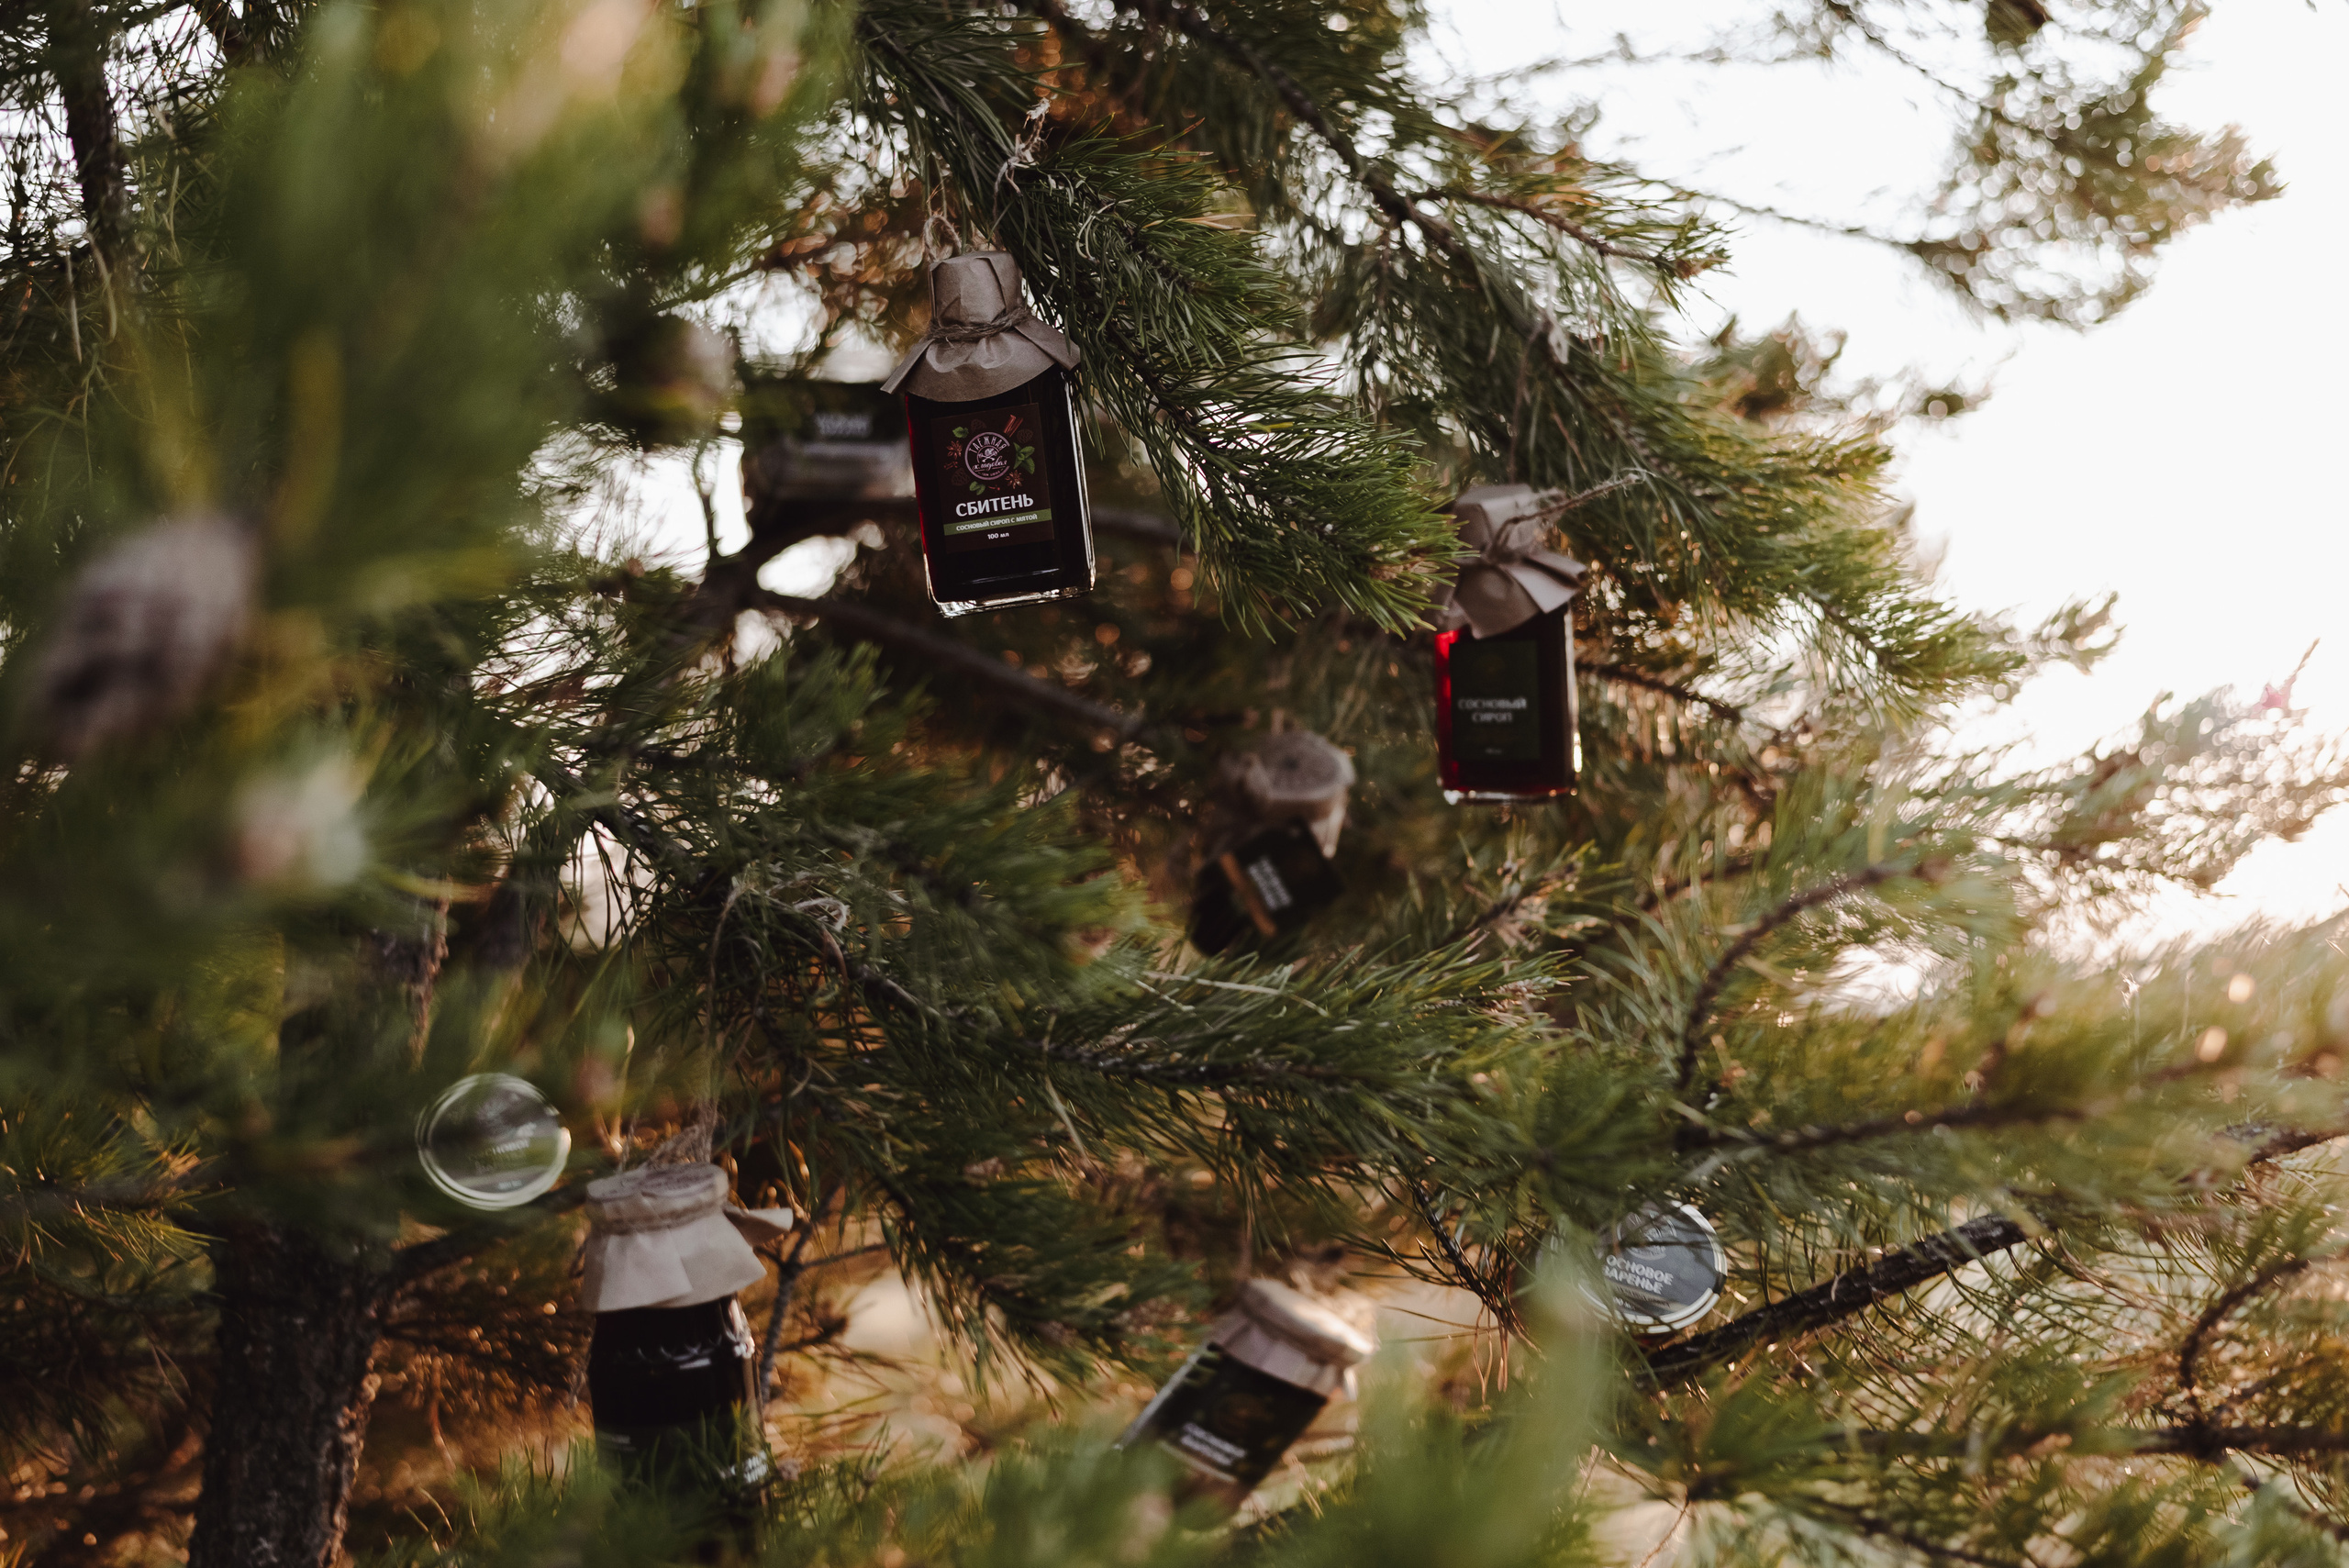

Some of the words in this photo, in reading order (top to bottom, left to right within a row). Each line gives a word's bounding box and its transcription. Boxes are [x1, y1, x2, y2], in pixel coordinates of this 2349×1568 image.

[969, 436, 1008, 453] ТАЕЖНАЯ
[955, 494, 1034, 517] СБИТЕНЬ
[956, 520, 989, 531] СОСНОВЫЙ
[990, 517, 1009, 527] СИРОП
[1016, 514, 1038, 523] МЯТОЙ
[1457, 698, 1527, 710] СОСНОВЫЙ
[1471, 711, 1513, 723] СИРОП
[1601, 1253, 1674, 1285] ОСНОВОЕ
